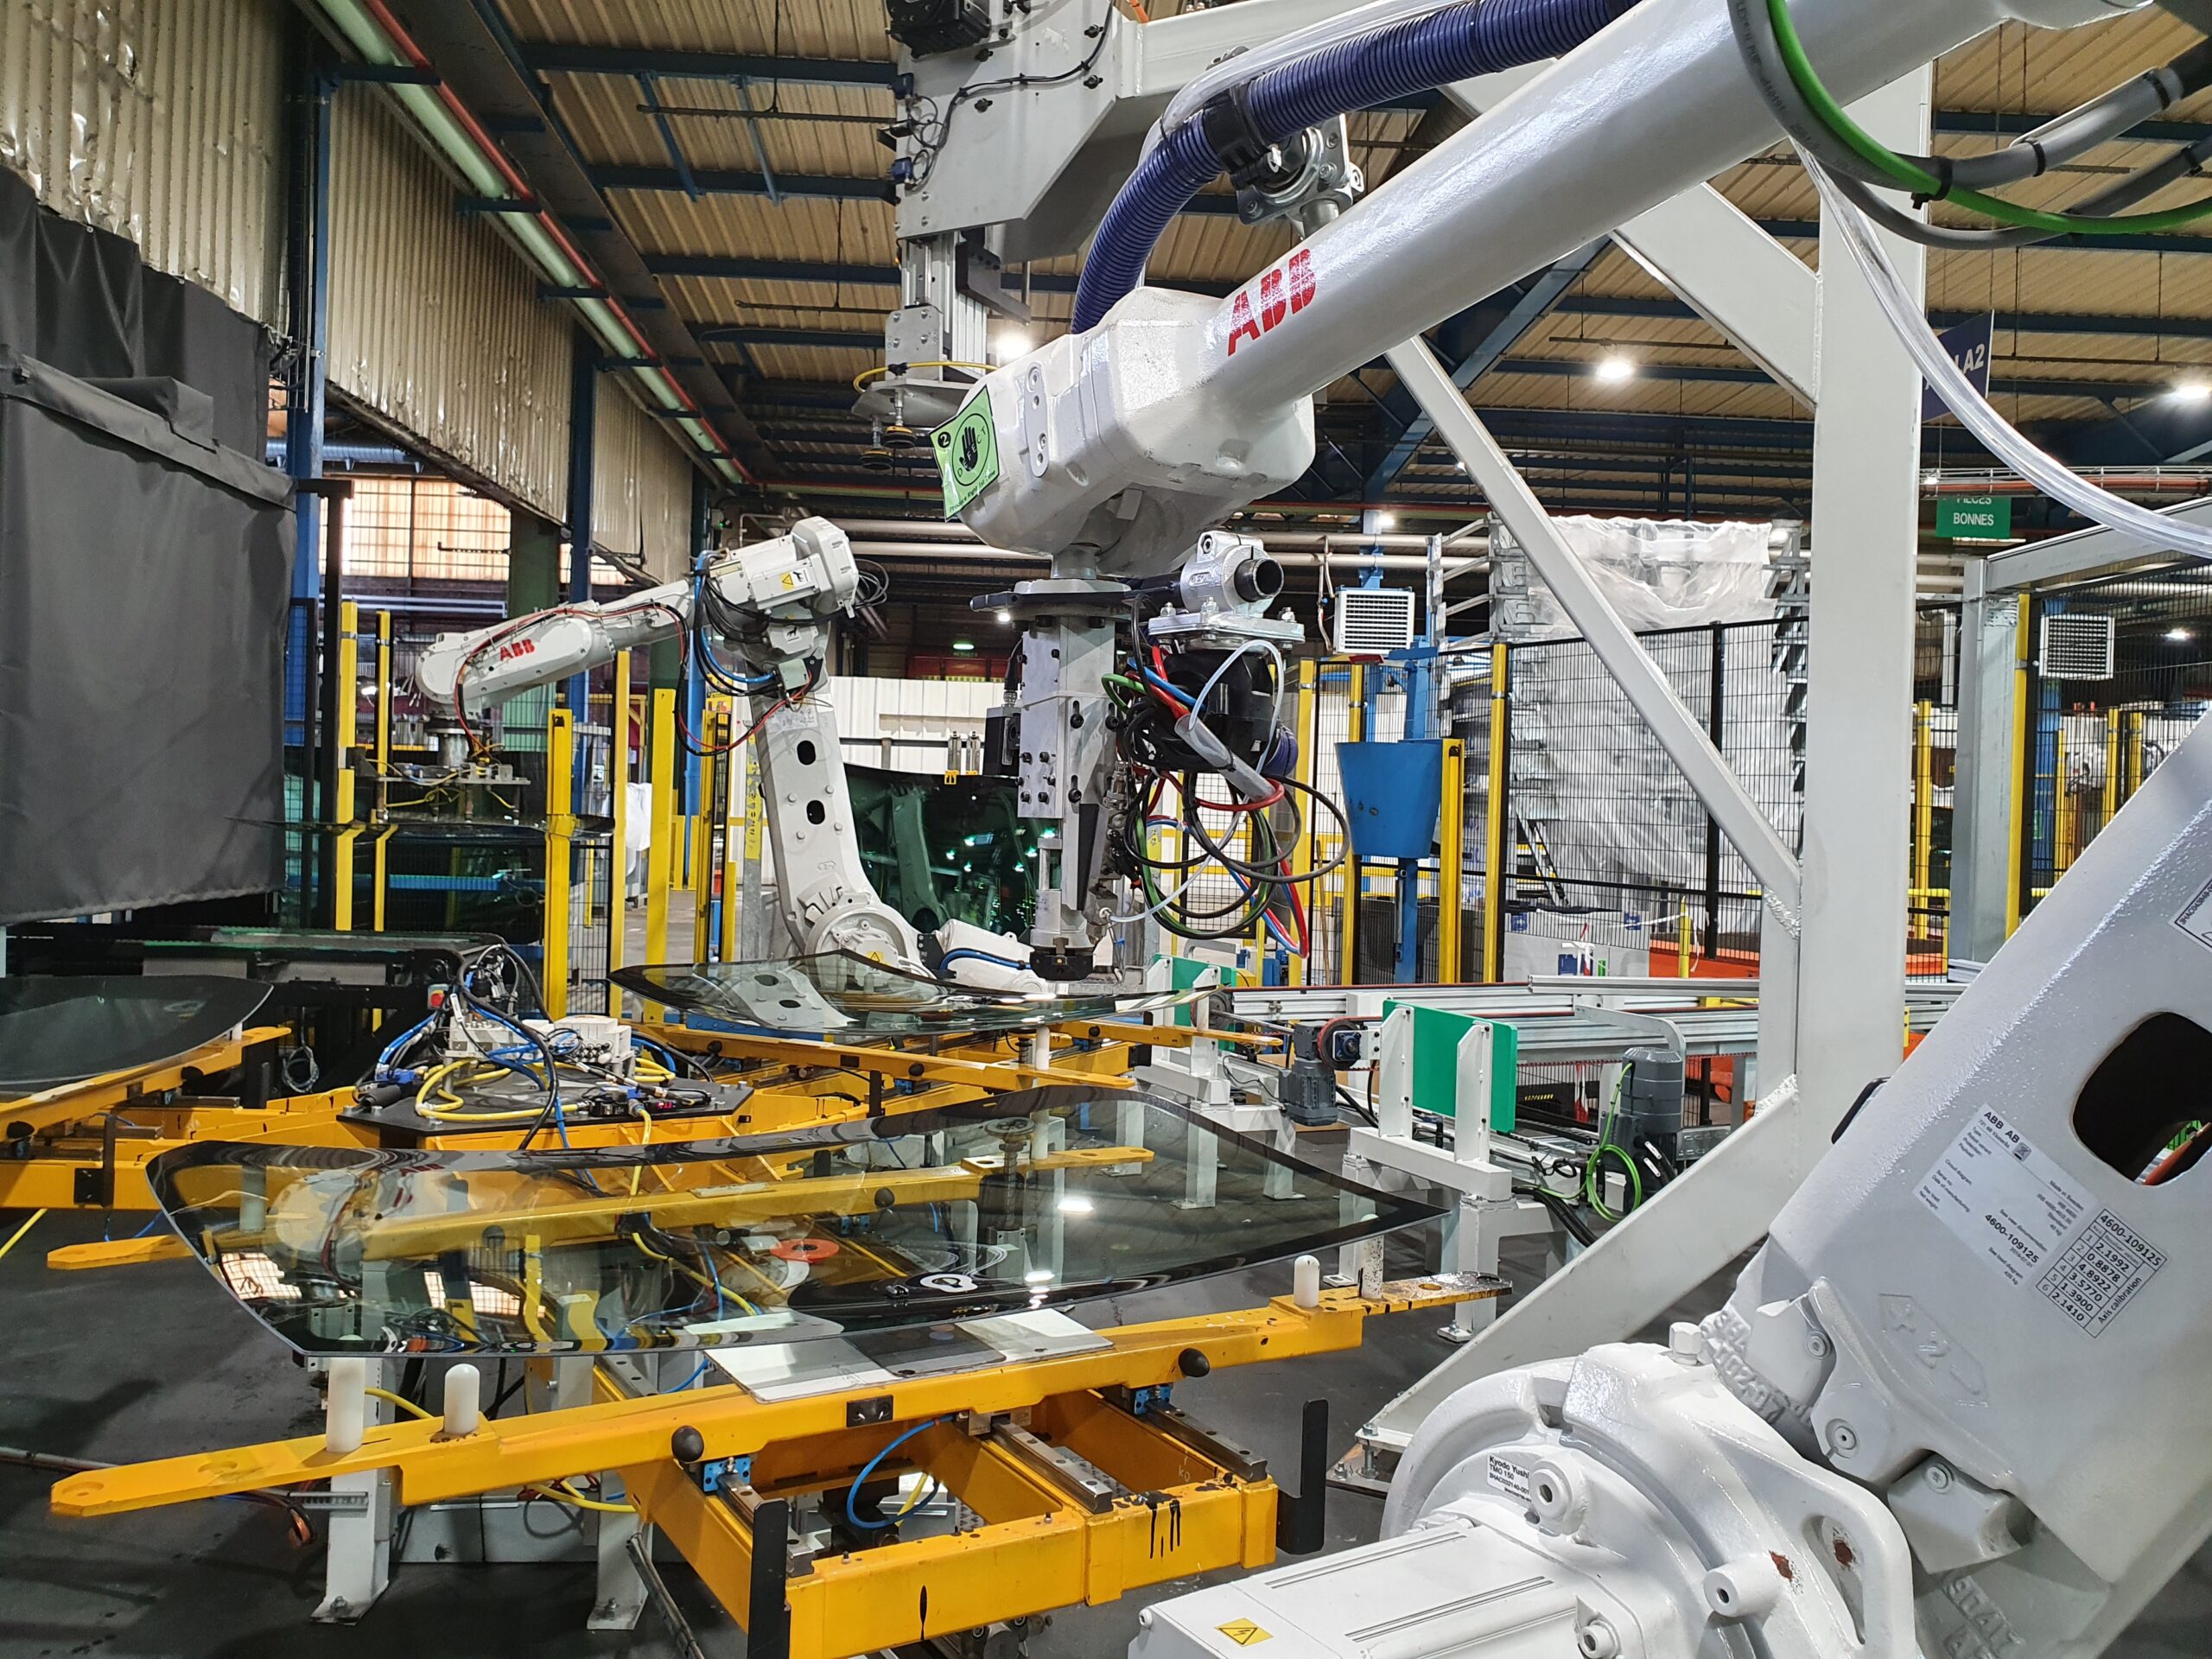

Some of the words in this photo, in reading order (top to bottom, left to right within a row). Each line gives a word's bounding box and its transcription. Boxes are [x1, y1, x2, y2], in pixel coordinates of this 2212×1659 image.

[1228, 248, 1317, 357] ABB
[939, 434, 950, 447] 2
[957, 426, 987, 478] DEFECT
[1953, 512, 1994, 526] BONNES
[499, 639, 536, 662] ABB
[1985, 1111, 2004, 1129] ABB
[2005, 1129, 2019, 1142] AB
[1985, 1214, 2039, 1263] 4600-109125
[2100, 1215, 2160, 1266] 4600-109125
[2087, 1254, 2120, 1282] 0.8878
[2096, 1243, 2129, 1272] 2.1992
[2069, 1273, 2102, 1301] 3.5770
[2078, 1263, 2111, 1292] 4.8922
[2052, 1293, 2084, 1321] 2.1410
[2061, 1283, 2094, 1312] 1.3900
[2097, 1309, 2112, 1323] Axis
[2110, 1278, 2141, 1309] calibration
[1489, 1455, 1510, 1471] Kyodo
[1504, 1471, 1514, 1480] 150
